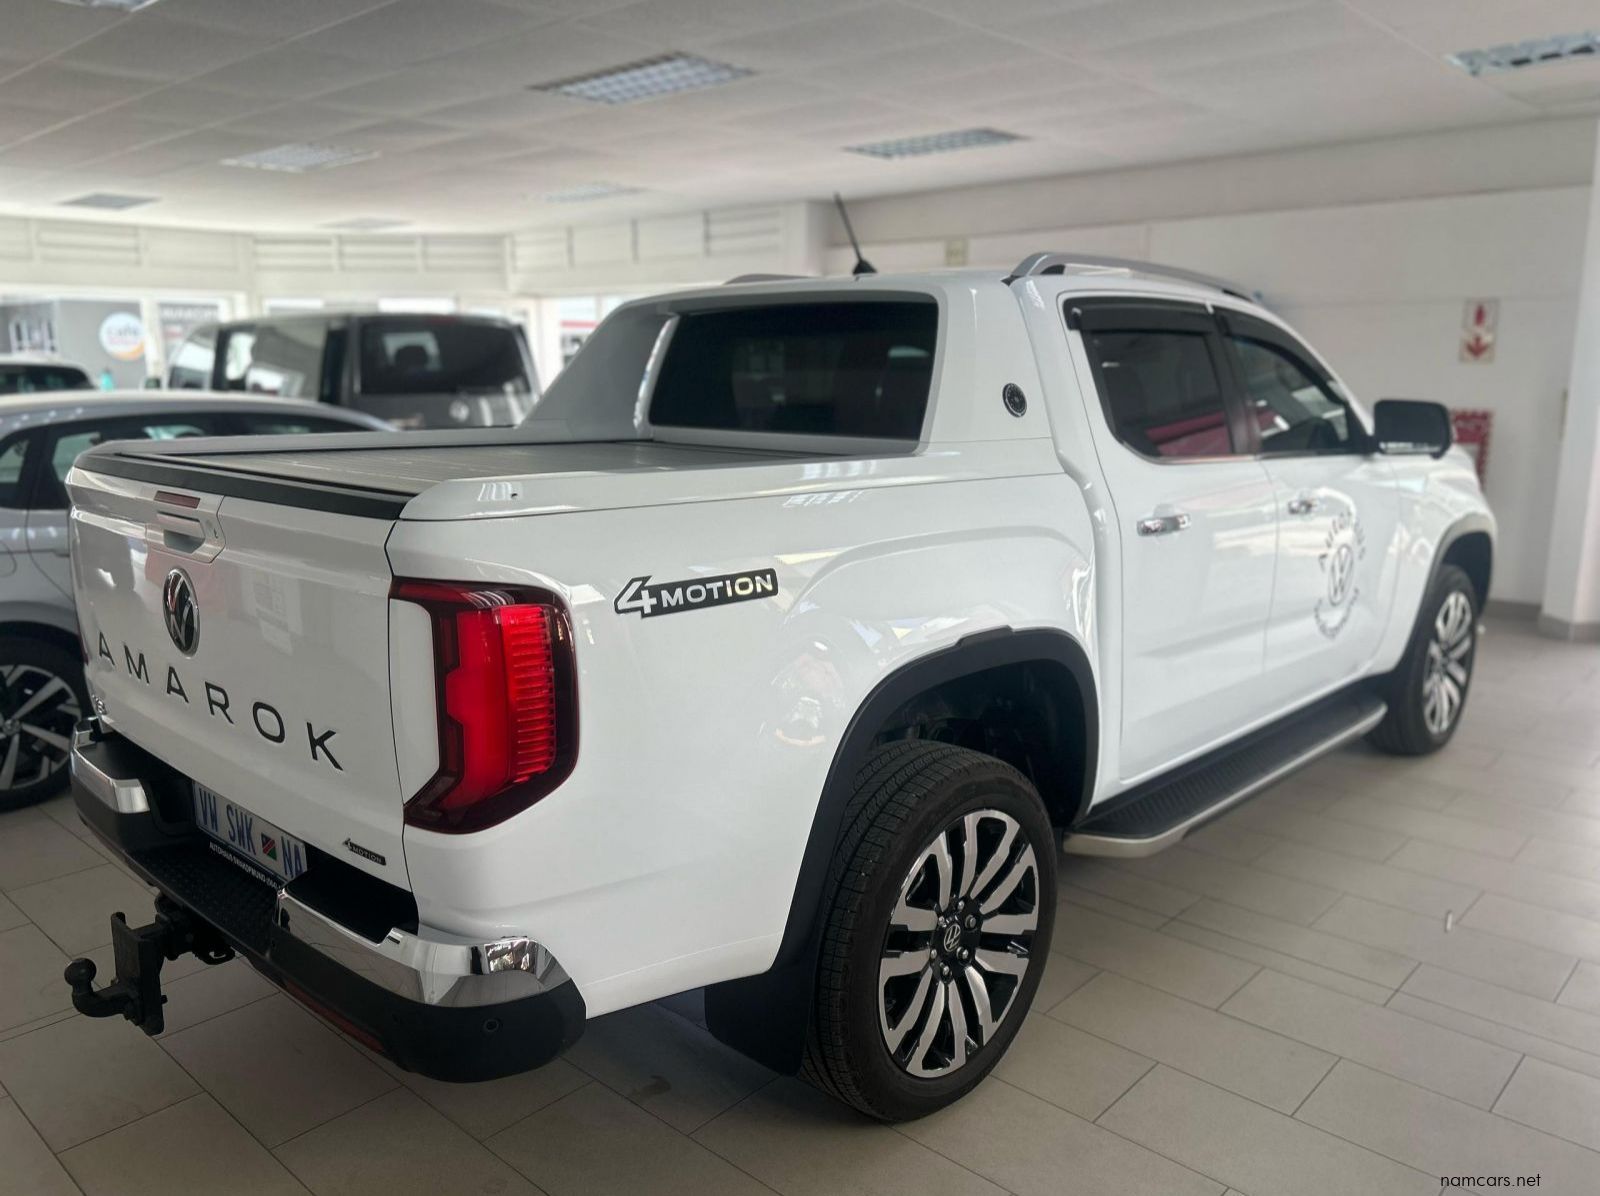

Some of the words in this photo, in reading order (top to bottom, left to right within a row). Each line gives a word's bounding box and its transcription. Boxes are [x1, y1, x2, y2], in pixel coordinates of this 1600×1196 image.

[615, 572, 775, 616] 4MOTION
[98, 631, 344, 772] AMAROK
[198, 787, 219, 833] VW
[226, 803, 256, 856] SWK
[280, 836, 304, 881] NA
[342, 837, 387, 866] 4MOTION
